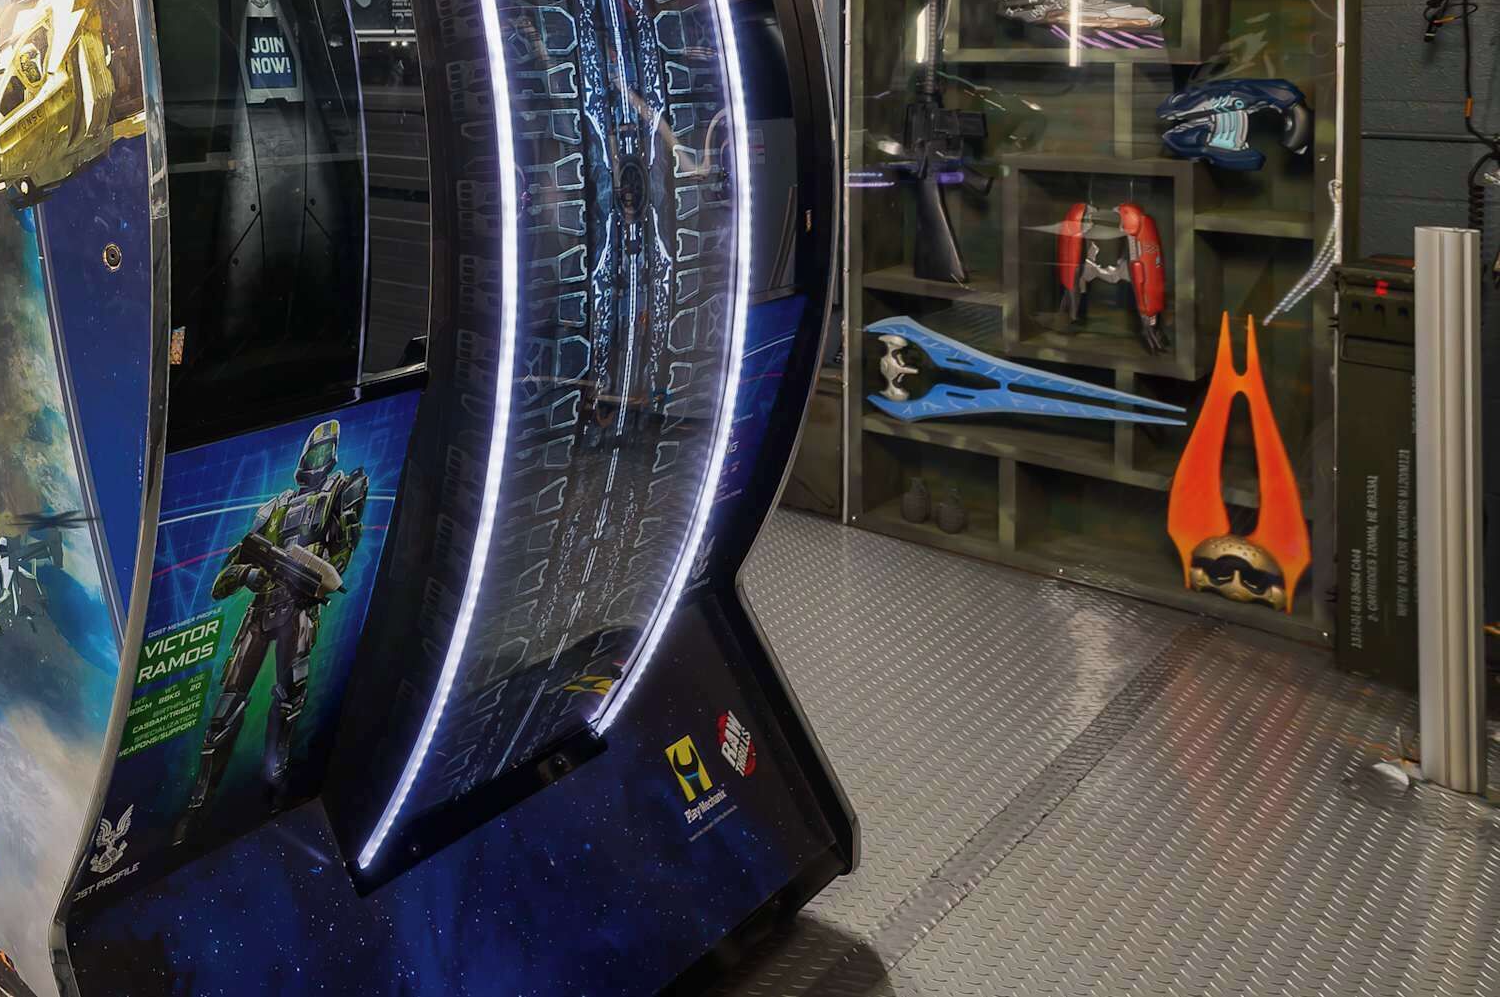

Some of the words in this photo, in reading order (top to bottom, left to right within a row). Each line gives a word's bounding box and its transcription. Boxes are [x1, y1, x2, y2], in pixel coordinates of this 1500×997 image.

[251, 36, 285, 54] JOIN
[250, 56, 292, 74] NOW!
[143, 619, 220, 659] VICTOR
[137, 641, 215, 684] RAMOS
[95, 861, 141, 891] PROFILE
